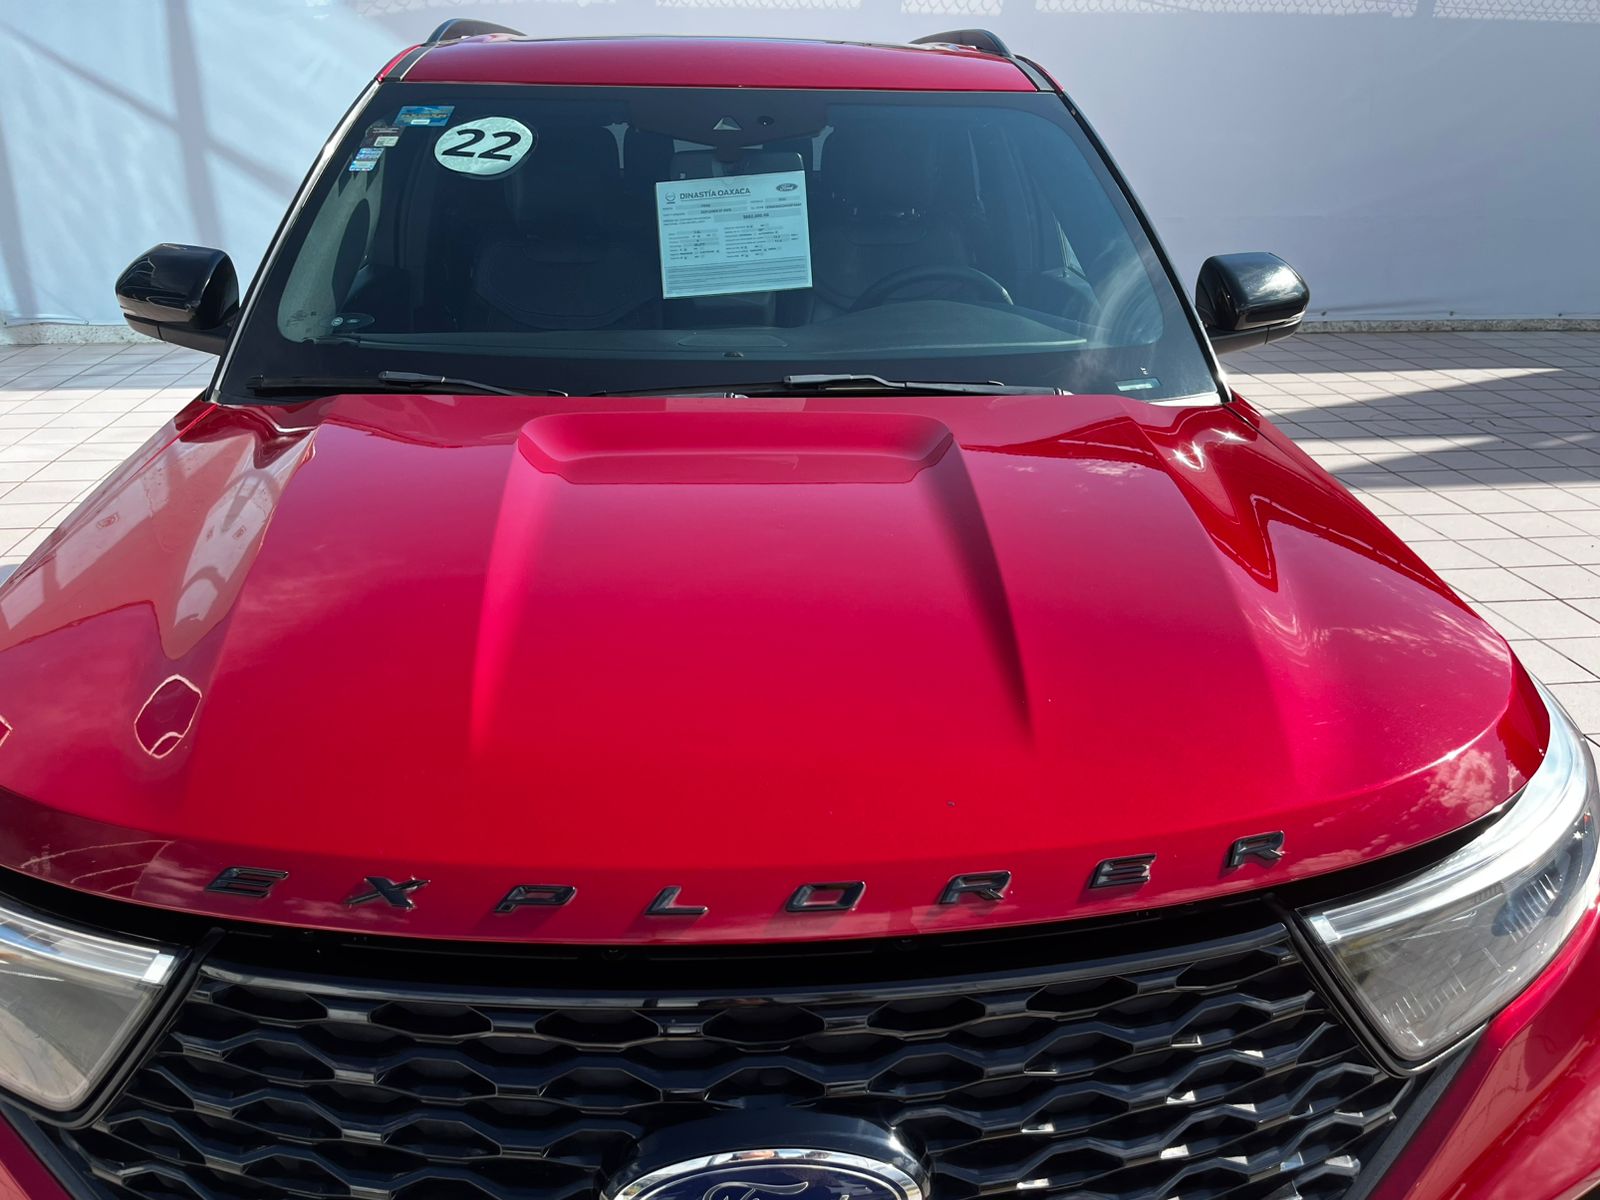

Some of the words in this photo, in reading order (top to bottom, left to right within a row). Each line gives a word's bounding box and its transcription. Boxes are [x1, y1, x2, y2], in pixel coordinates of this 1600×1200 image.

[441, 128, 522, 162] 22
[679, 189, 716, 199] DINASTÍA
[717, 187, 751, 196] OAXACA
[204, 830, 1286, 916] EXPLORER
